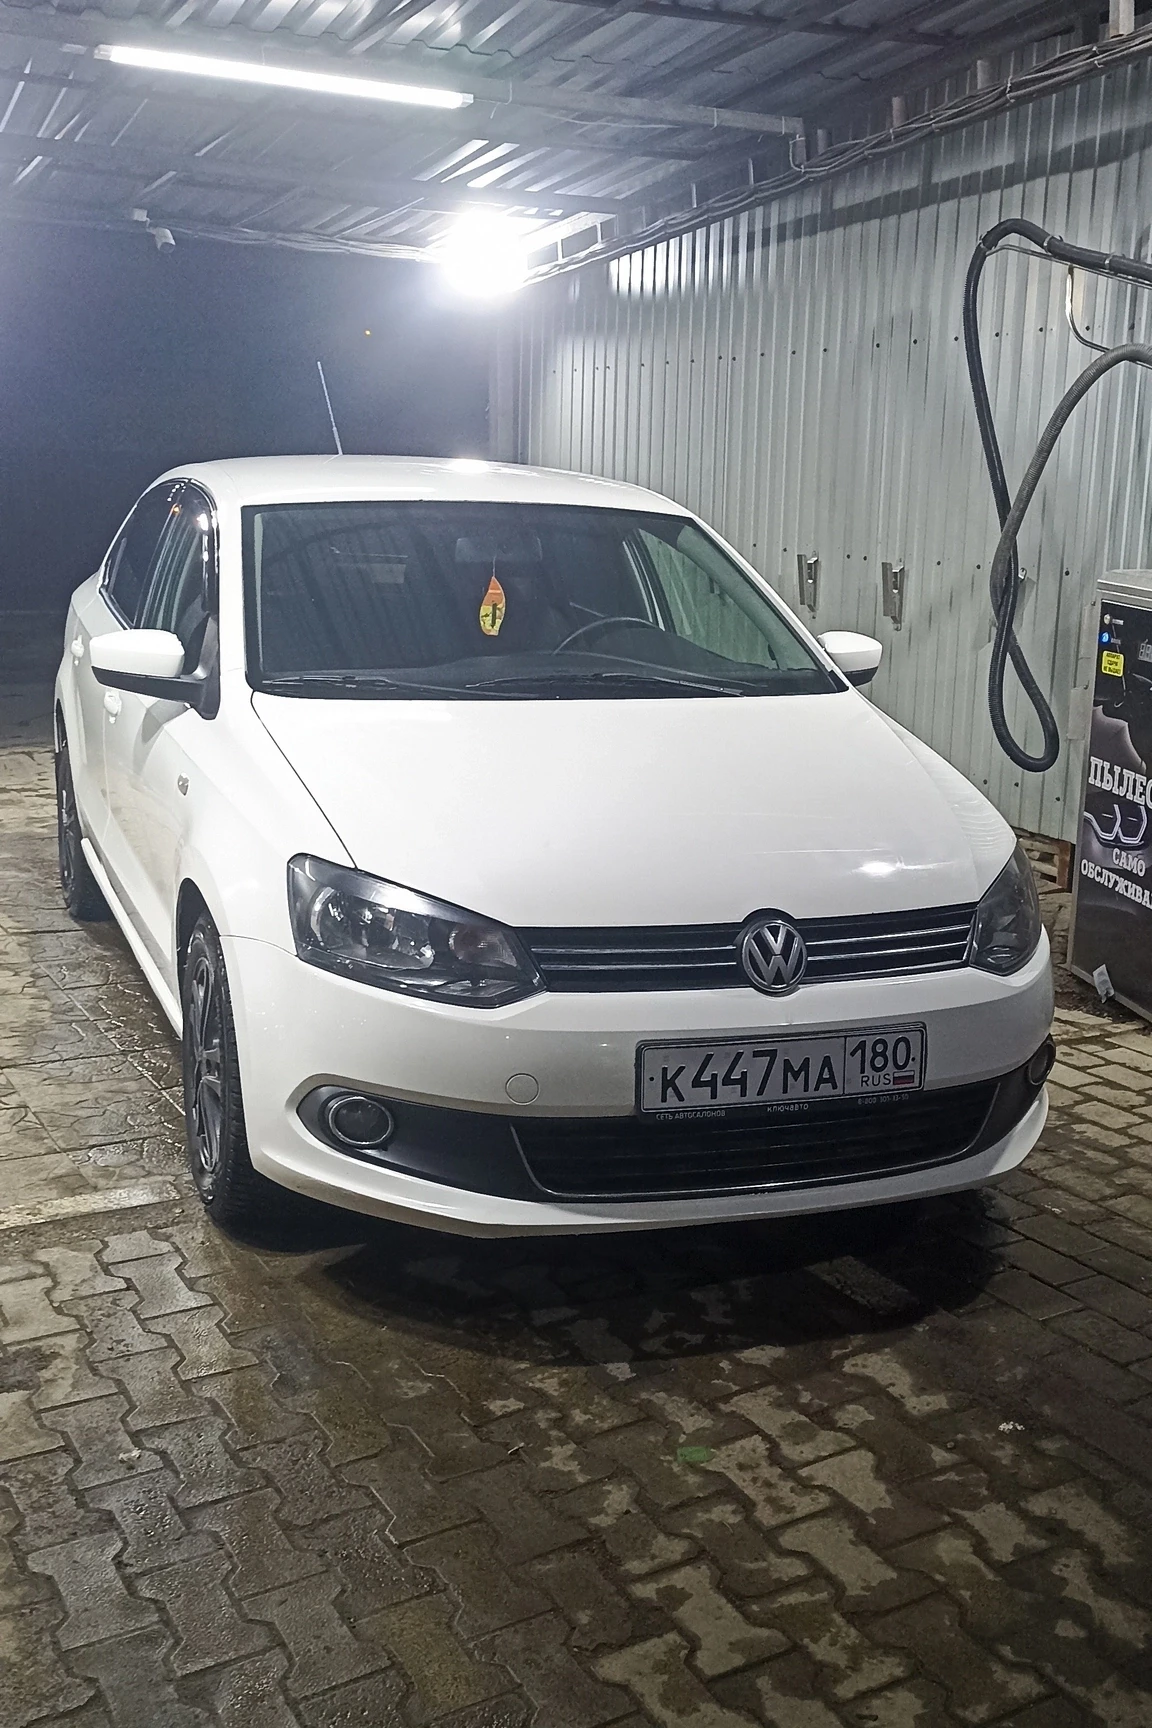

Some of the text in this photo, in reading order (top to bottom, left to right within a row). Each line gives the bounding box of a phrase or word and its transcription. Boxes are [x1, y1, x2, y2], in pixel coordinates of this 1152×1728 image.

[1113, 848, 1146, 877] САМО
[1081, 859, 1152, 910] ОБСЛУЖИВА
[850, 1036, 911, 1074] 180
[861, 1073, 891, 1087] RUS
[675, 1110, 726, 1119] АВТОСАЛОНОВ
